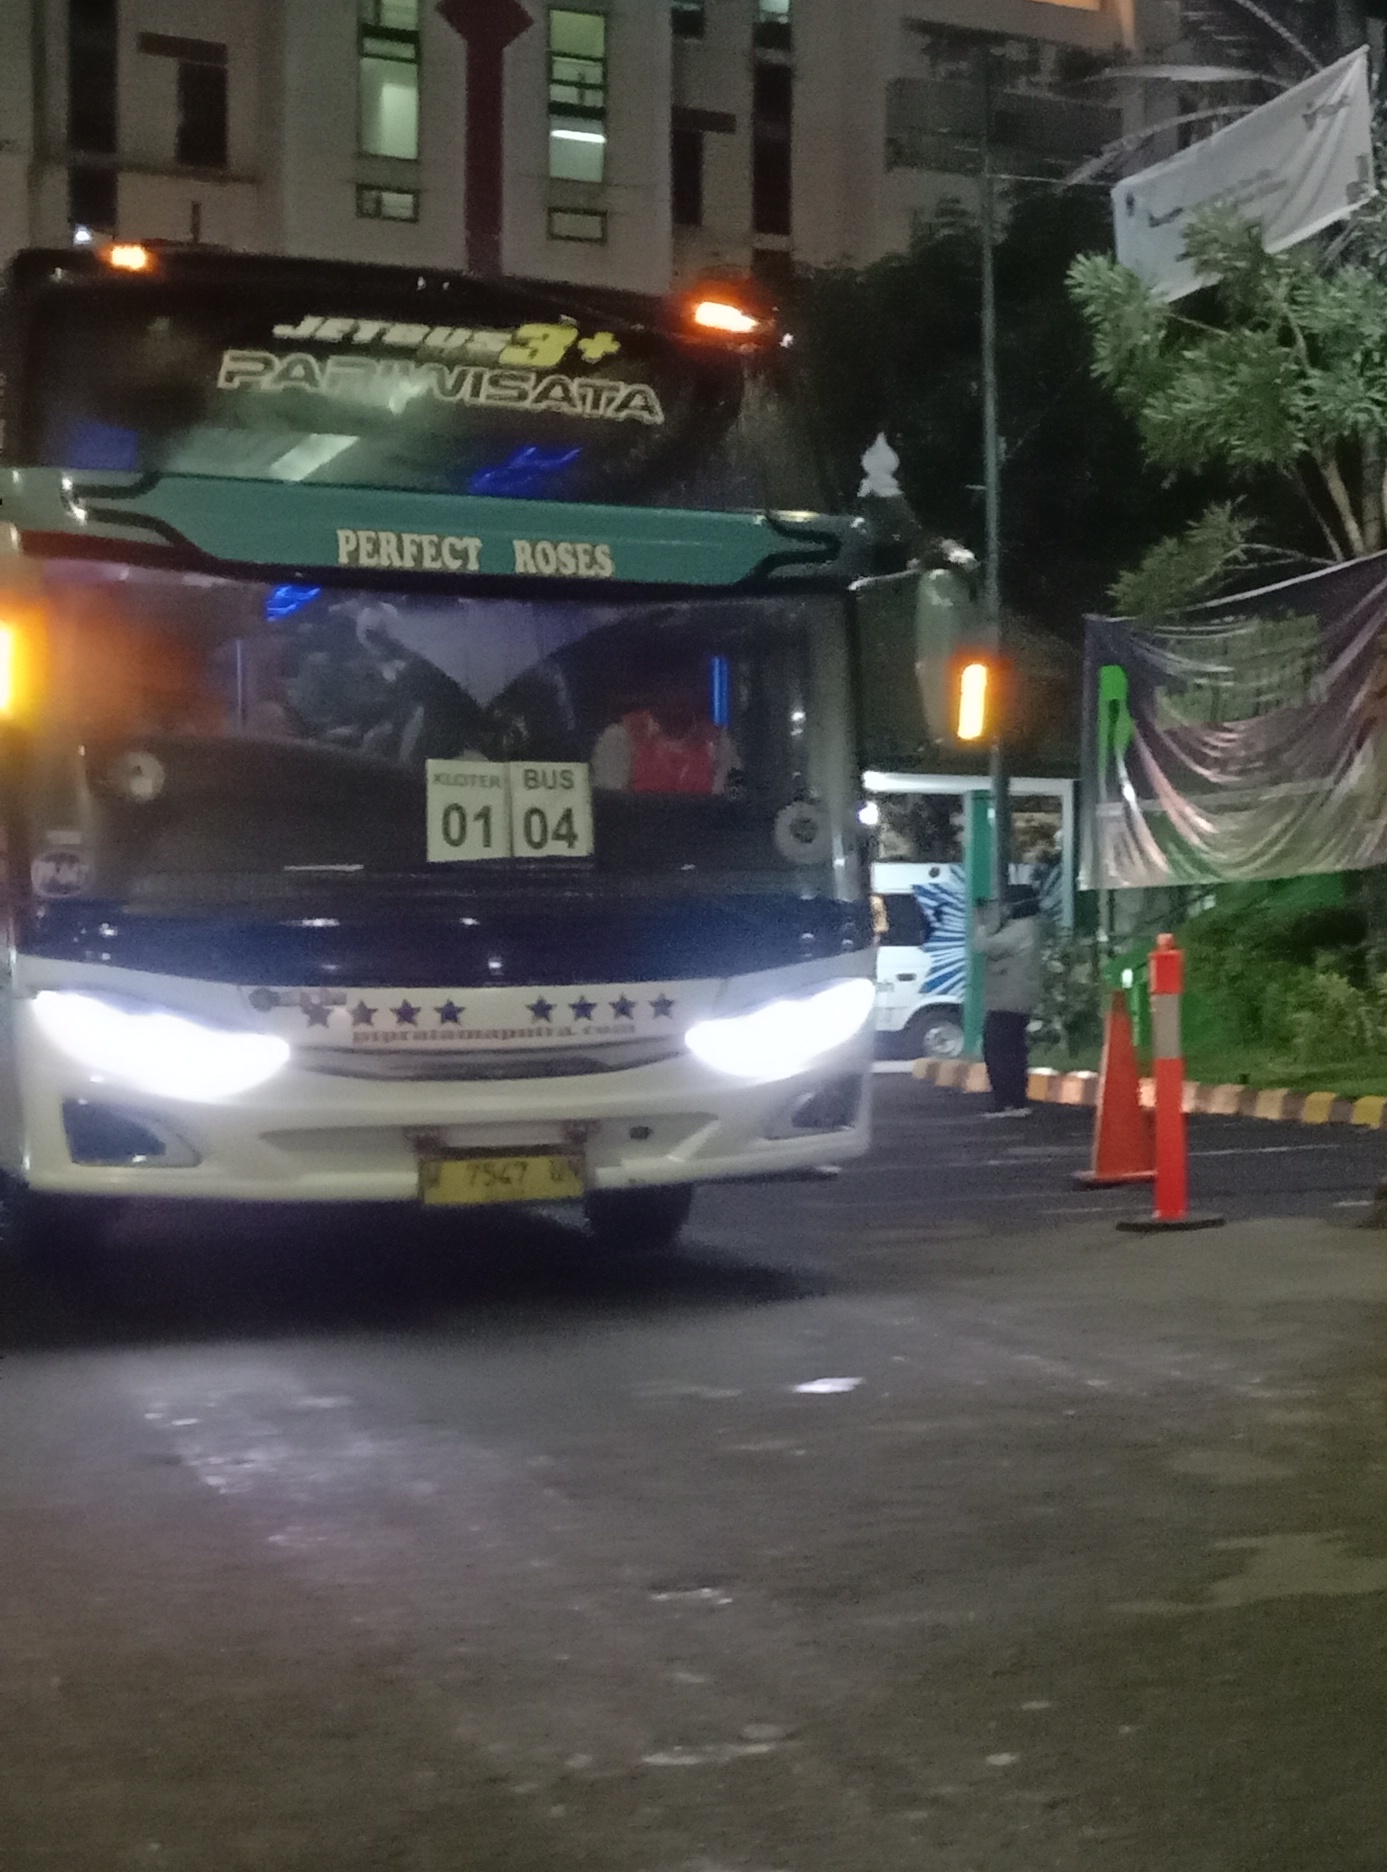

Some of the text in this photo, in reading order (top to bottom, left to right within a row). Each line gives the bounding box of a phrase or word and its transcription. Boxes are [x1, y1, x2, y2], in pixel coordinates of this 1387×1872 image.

[217, 349, 665, 425] PARIWISATA
[337, 529, 615, 577] PERFECT ROSES
[523, 768, 574, 790] BUS
[441, 803, 493, 848] 01
[523, 807, 578, 849] 04
